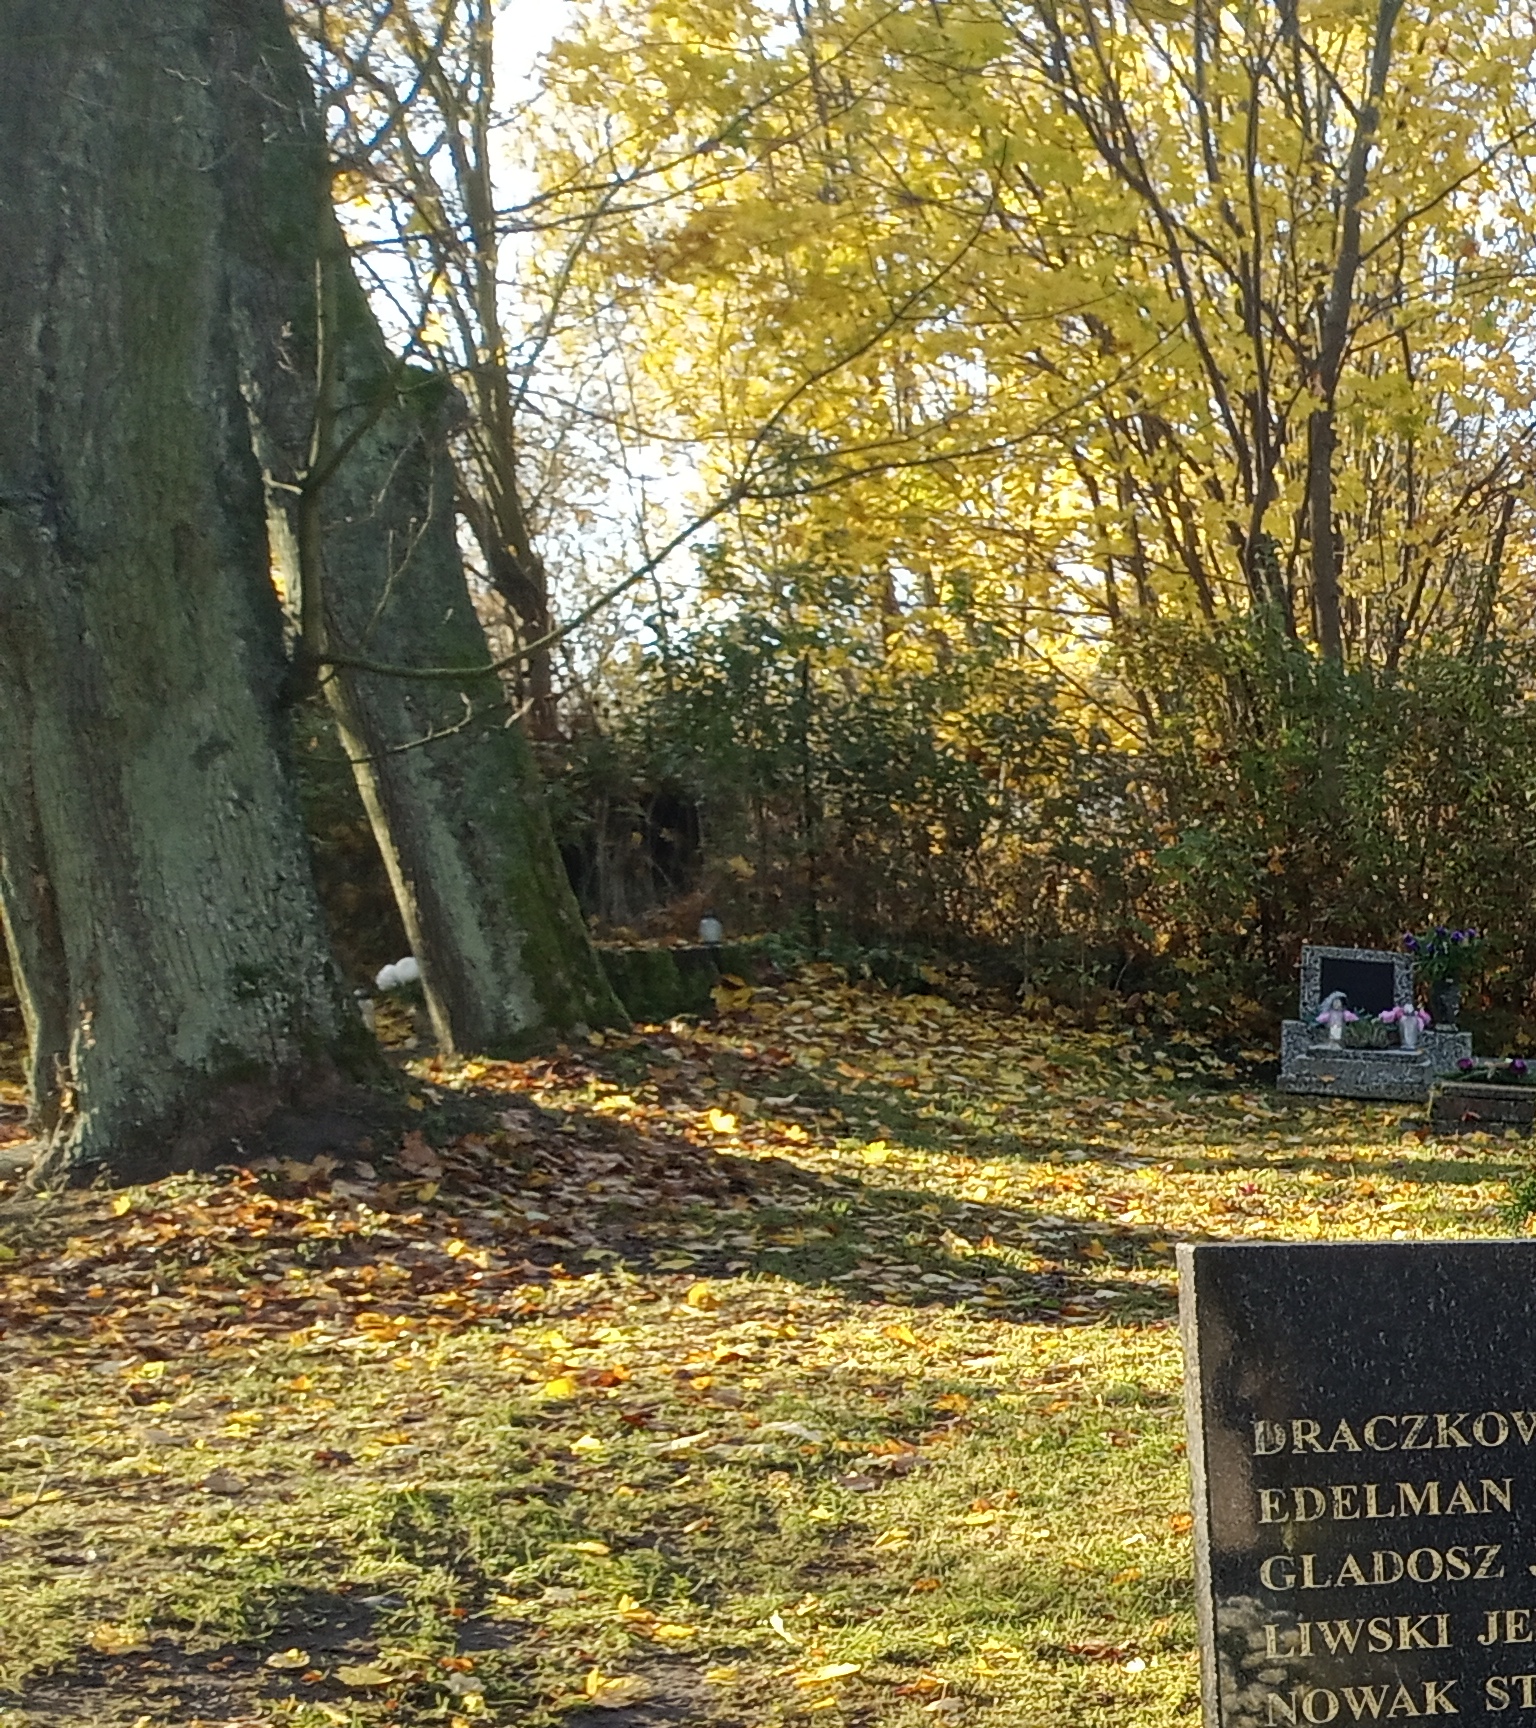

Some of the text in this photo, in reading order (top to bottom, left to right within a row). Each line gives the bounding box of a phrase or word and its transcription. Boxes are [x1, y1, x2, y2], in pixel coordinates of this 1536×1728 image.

[1260, 1478, 1512, 1524] EDELMAN
[1261, 1546, 1503, 1590] GLADOSZ
[1265, 1615, 1449, 1658] LIWSKI
[1268, 1679, 1456, 1725] NOWAK
